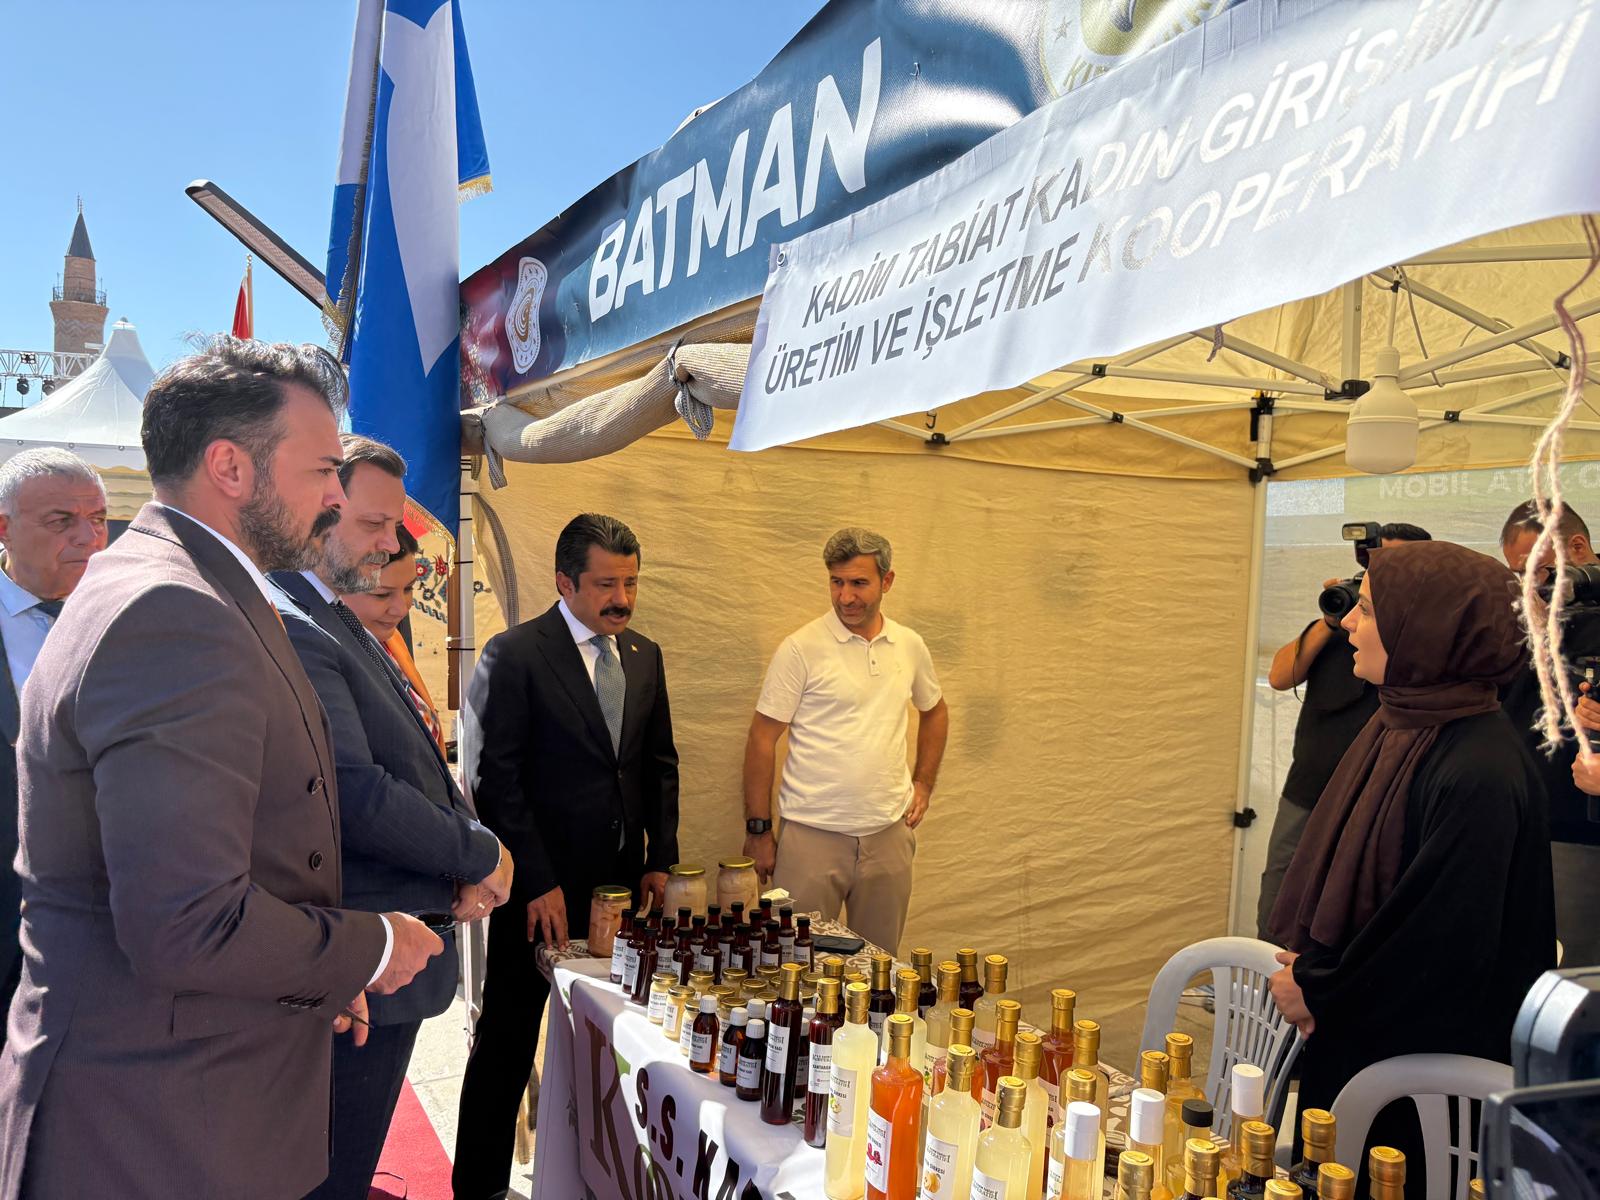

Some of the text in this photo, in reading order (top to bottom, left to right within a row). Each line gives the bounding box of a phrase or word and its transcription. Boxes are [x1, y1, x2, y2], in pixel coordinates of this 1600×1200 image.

[588, 36, 882, 324] BATMAN
[801, 251, 900, 329] KADİM
[898, 186, 1024, 290] TABİAT
[1018, 115, 1194, 233] KADIN
[764, 320, 864, 395] ÜRETİM
[870, 305, 913, 365] VE
[913, 231, 1081, 361] İŞLETME
